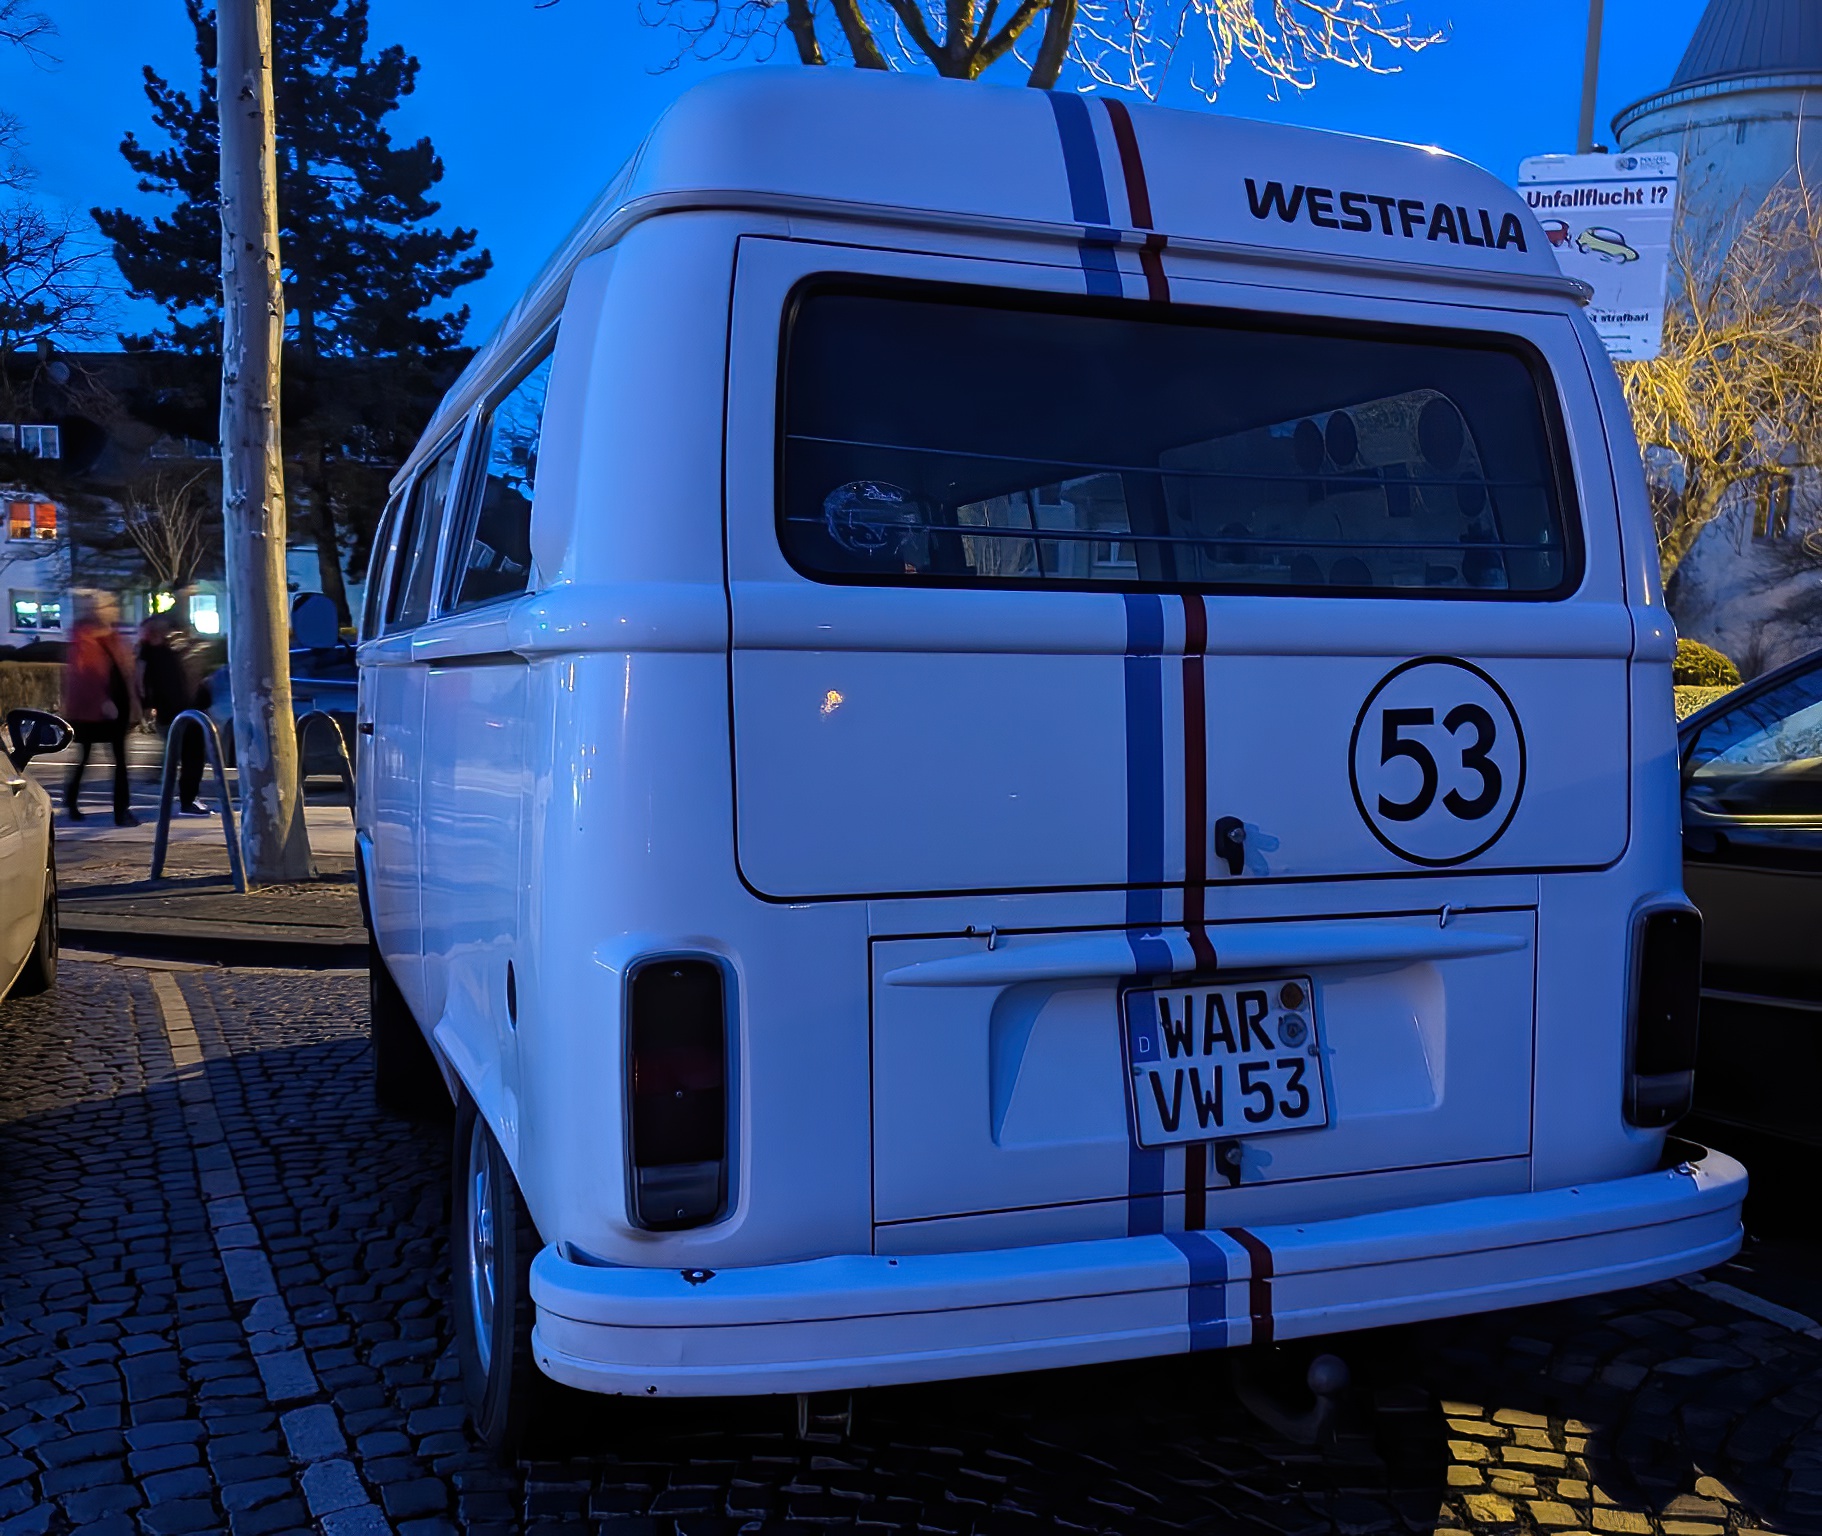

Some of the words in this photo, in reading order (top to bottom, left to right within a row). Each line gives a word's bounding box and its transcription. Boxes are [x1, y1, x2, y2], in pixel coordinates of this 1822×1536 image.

[1244, 177, 1528, 253] WESTFALIA
[1526, 187, 1644, 209] Unfallflucht
[1650, 186, 1668, 204] !?
[1378, 703, 1502, 822] 53
[1138, 1036, 1150, 1053] D
[1158, 990, 1275, 1059] WAR
[1149, 1065, 1224, 1132] VW
[1238, 1057, 1310, 1123] 53
